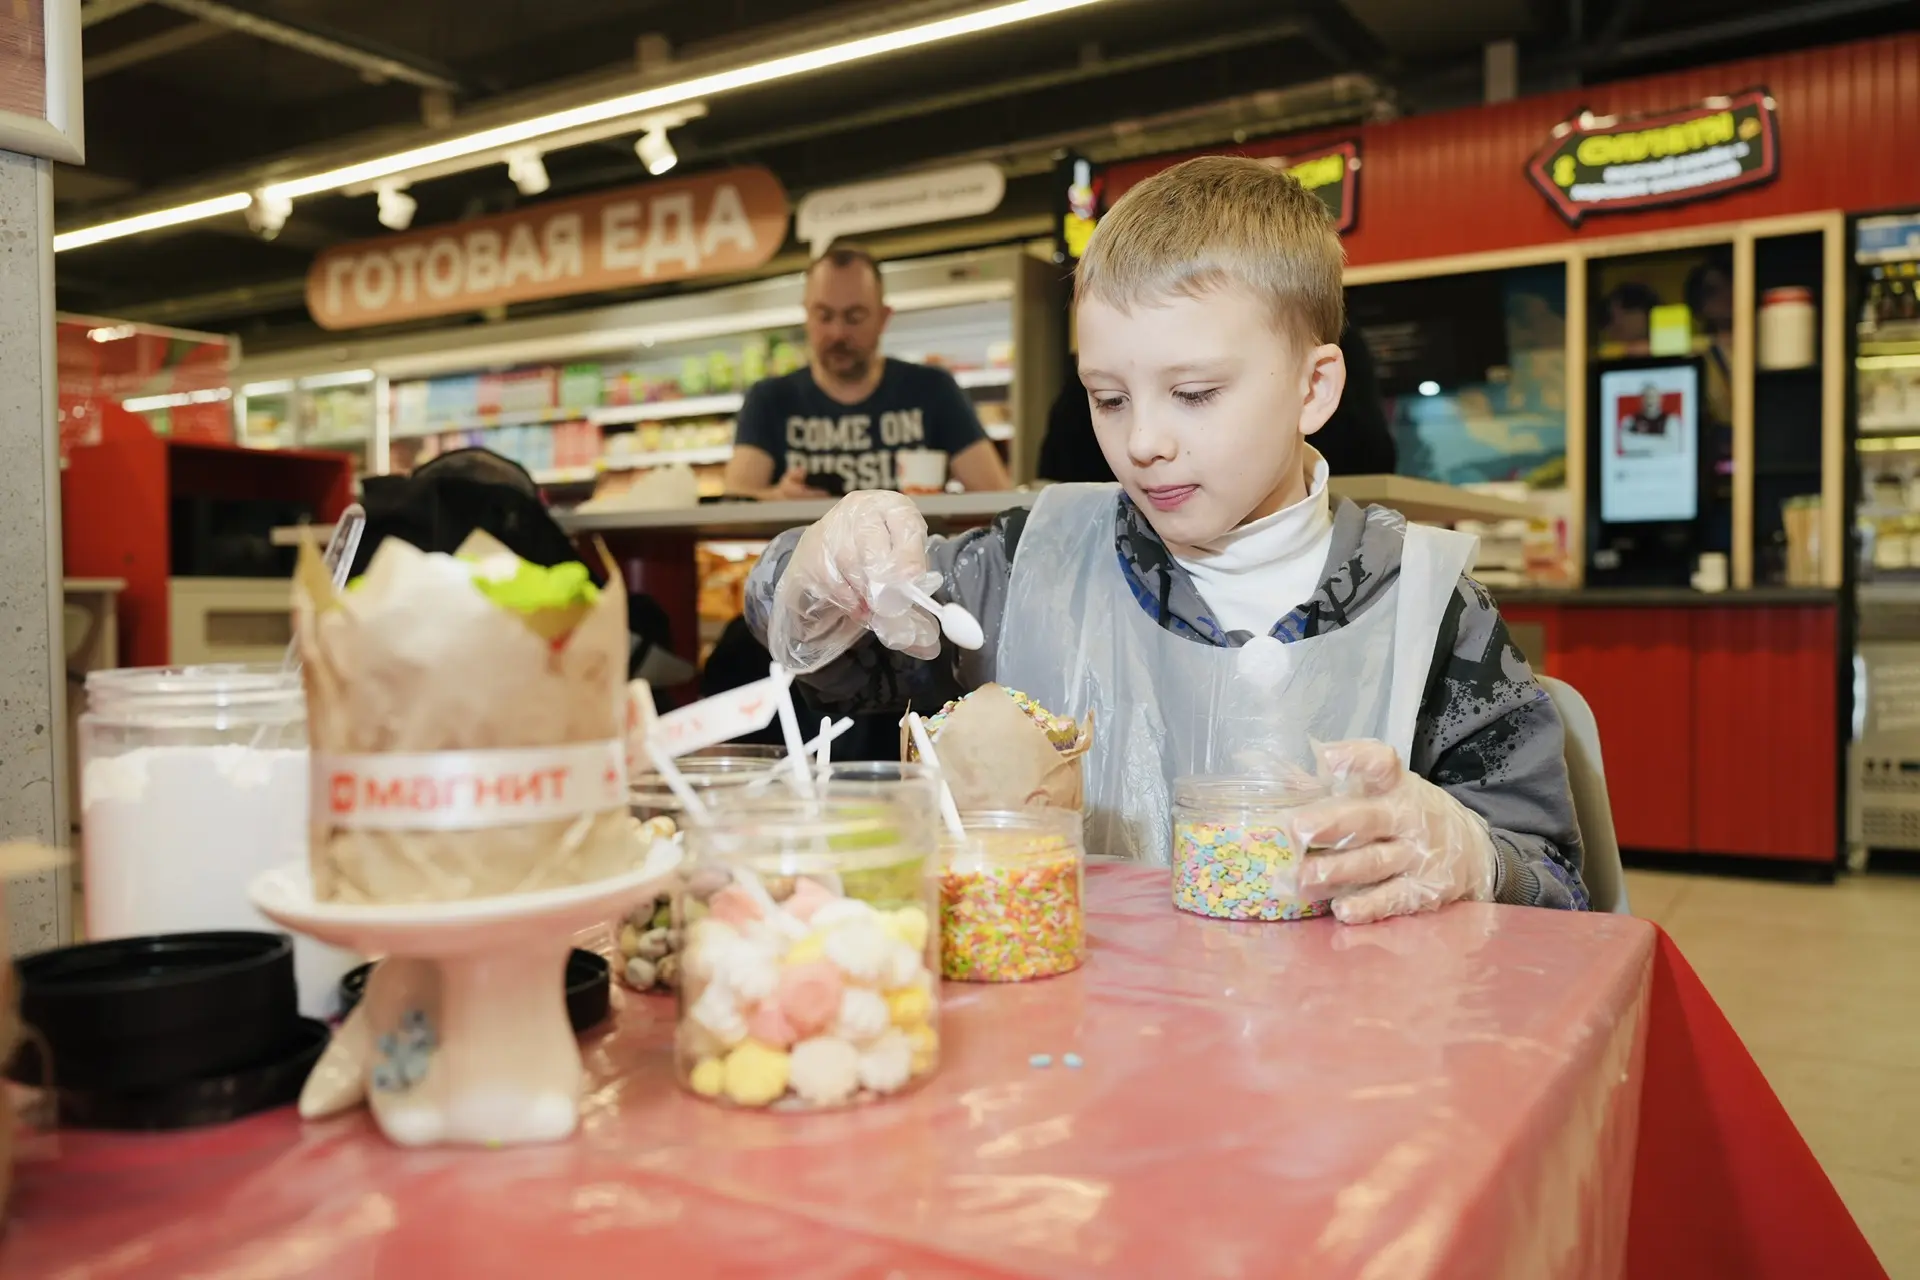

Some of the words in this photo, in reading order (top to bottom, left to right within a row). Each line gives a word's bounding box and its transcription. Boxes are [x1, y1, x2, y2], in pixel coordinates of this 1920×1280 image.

[325, 213, 582, 316] ГОТОВАЯ
[603, 184, 757, 278] ЕДА
[786, 415, 873, 451] COME
[879, 407, 924, 446] ON
